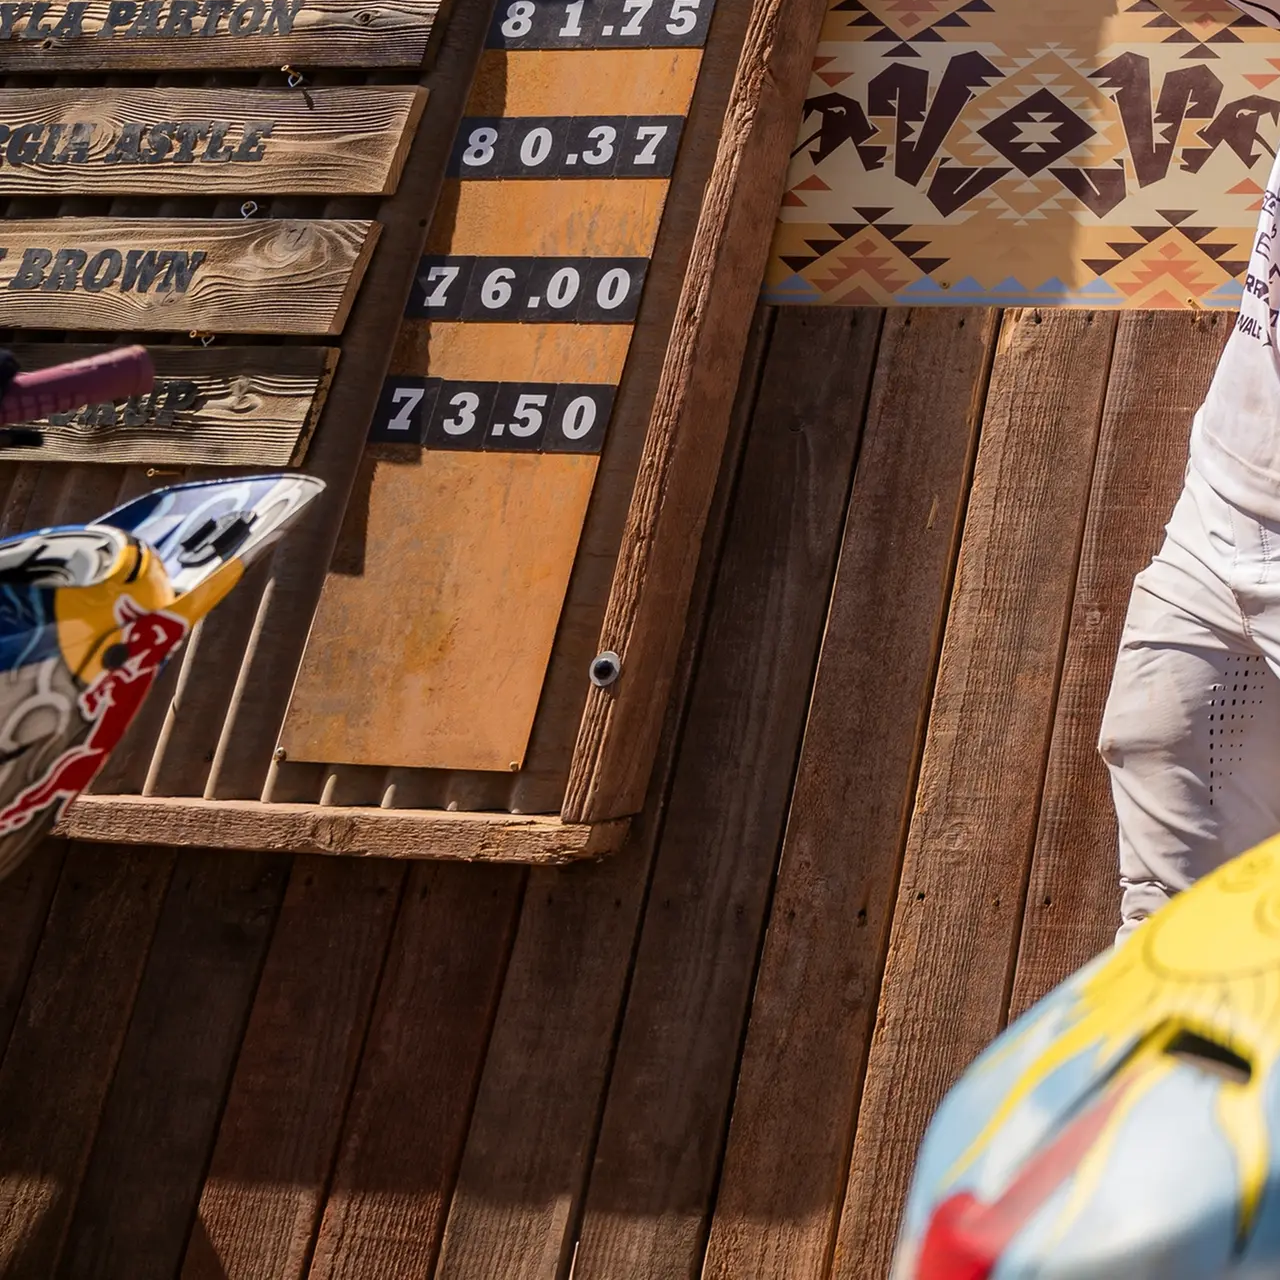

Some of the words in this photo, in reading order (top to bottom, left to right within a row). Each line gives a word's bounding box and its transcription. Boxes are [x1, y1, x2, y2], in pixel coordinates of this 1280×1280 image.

[104, 120, 275, 163] ASTLE
[461, 126, 666, 168] 80.37
[8, 248, 207, 294] BROWN
[423, 267, 634, 312] 76.00
[387, 386, 597, 442] 73.50
